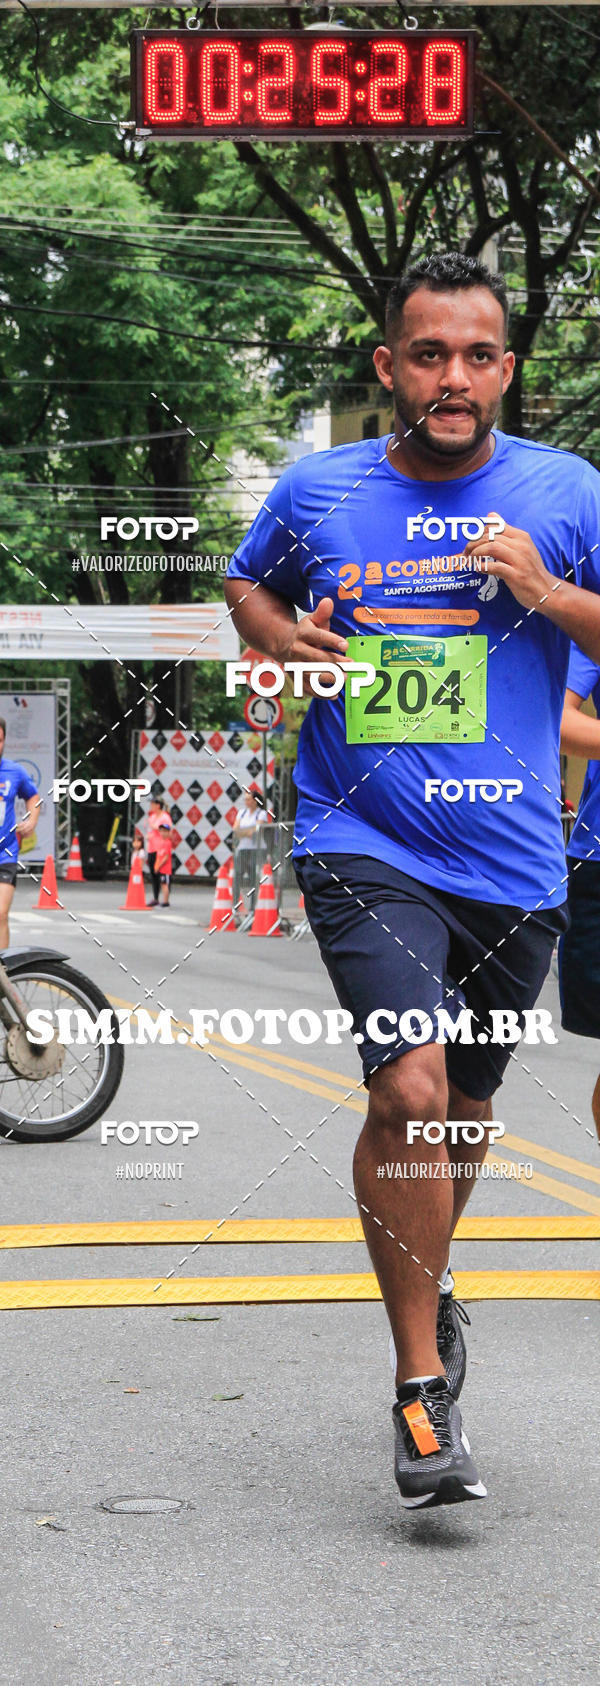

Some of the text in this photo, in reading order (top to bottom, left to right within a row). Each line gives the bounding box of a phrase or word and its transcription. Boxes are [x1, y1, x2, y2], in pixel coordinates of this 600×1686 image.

[412, 577, 424, 585] DO
[384, 587, 413, 596] SANTO
[413, 582, 465, 594] AGOSTINHO
[364, 669, 466, 715] 204
